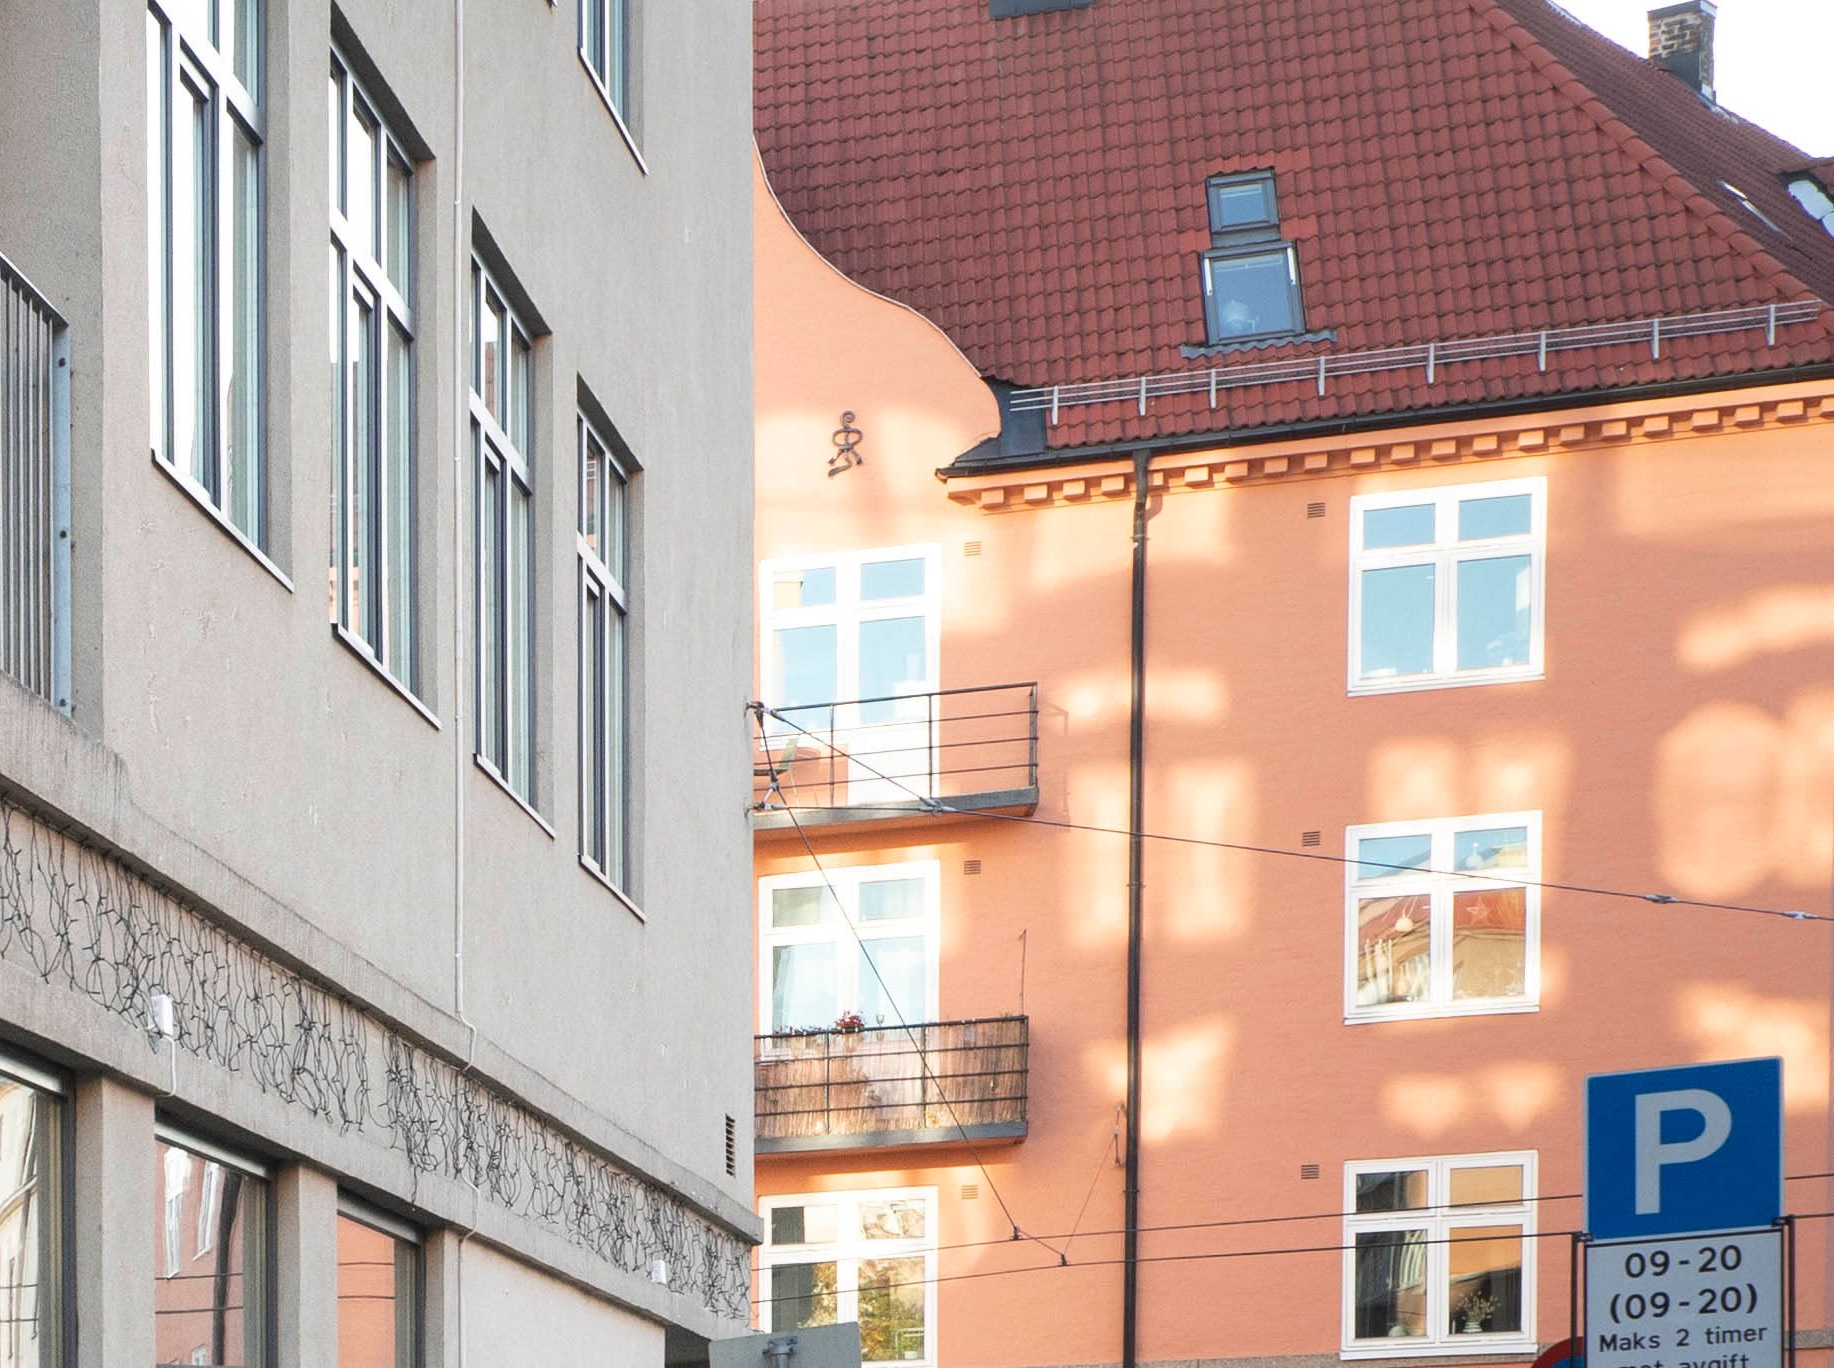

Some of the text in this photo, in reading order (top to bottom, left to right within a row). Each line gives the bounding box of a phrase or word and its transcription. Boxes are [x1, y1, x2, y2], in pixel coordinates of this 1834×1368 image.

[1633, 1087, 1734, 1215] P
[1598, 1325, 1769, 1353] Maks 2 timer
